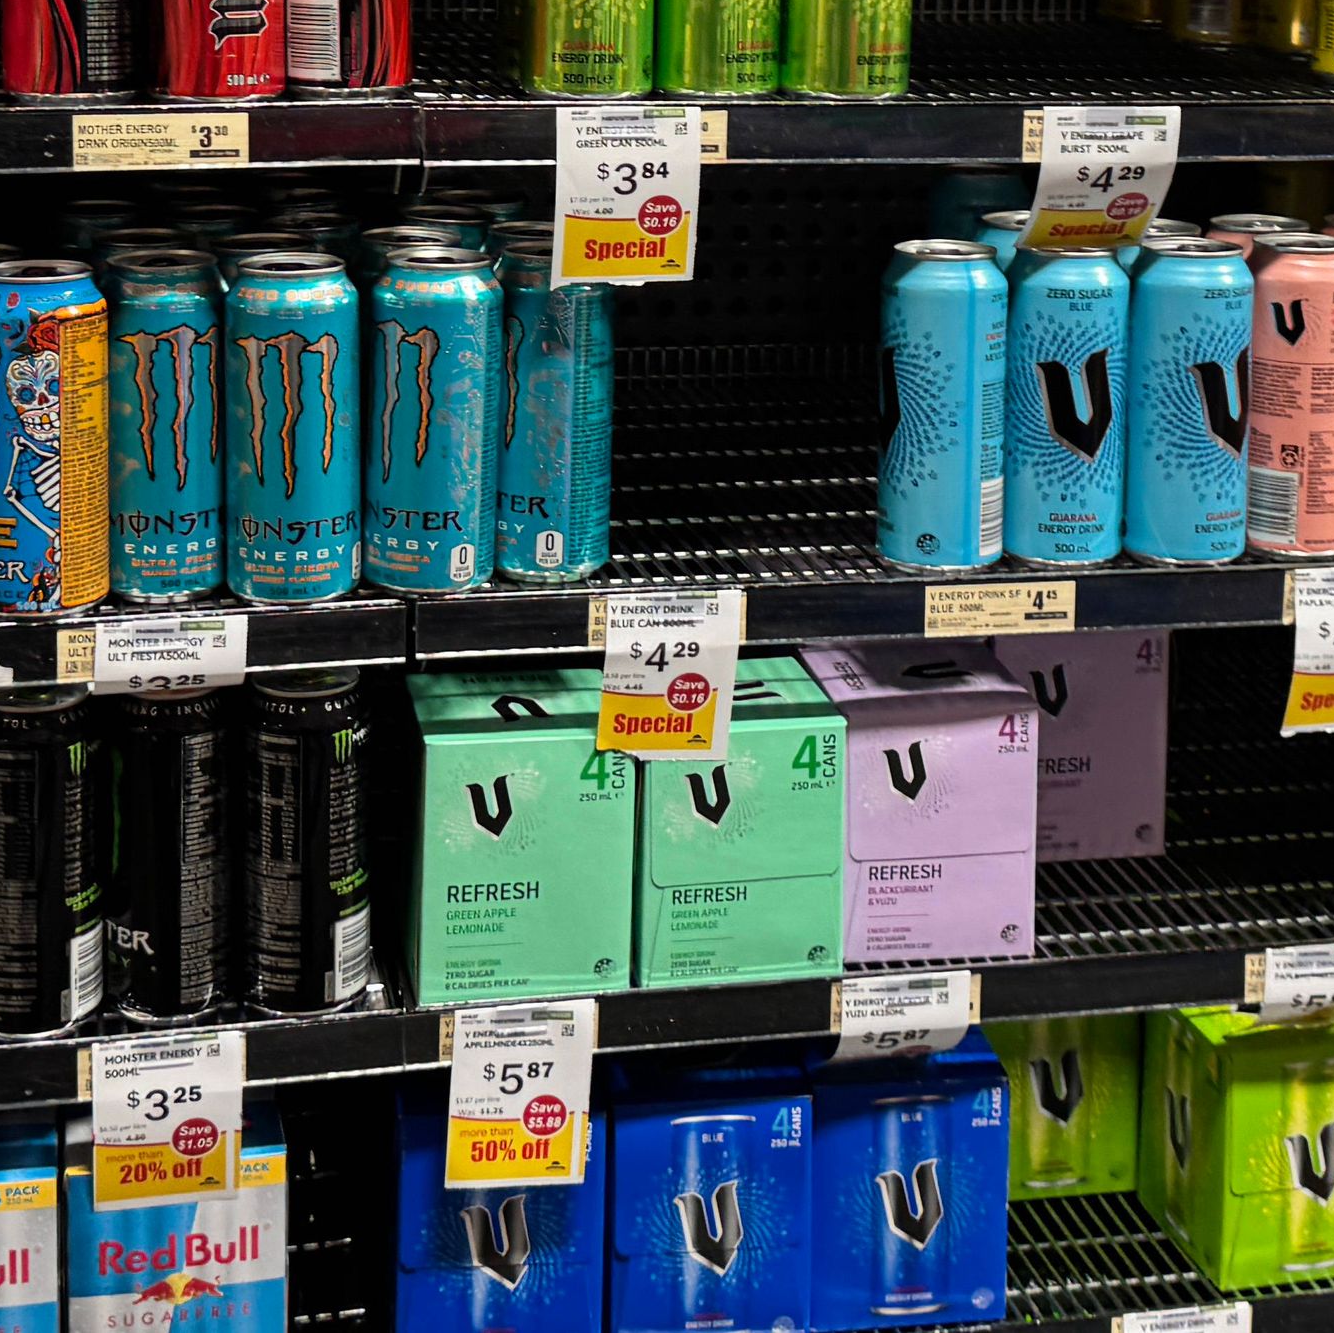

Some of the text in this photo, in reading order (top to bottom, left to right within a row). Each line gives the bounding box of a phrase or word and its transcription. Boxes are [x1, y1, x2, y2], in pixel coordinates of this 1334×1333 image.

[551, 51, 624, 65] ENERGY DRINK
[78, 124, 169, 135] MOTHER ENERGY
[645, 203, 677, 214] Save
[643, 217, 678, 229] $0.16
[1049, 220, 1127, 239] Special
[584, 237, 667, 262] Special
[1046, 287, 1113, 301] ZERO SUGAR
[1068, 301, 1093, 312] BLUE
[1037, 523, 1073, 535] ENERGY
[238, 544, 346, 562] ENERGY
[620, 605, 661, 615] ENERGY
[663, 604, 694, 614] DRINK
[613, 713, 693, 735] Special
[868, 862, 943, 881] REFRESH
[447, 881, 540, 904] REFRESH
[672, 885, 748, 906] REFRESH
[446, 907, 517, 920] GREEN APPLE
[446, 922, 505, 935] LEMONADE
[530, 1101, 562, 1114] Save
[527, 1116, 562, 1129] $5.88
[470, 1138, 551, 1163] 50% off
[119, 1158, 204, 1185] 20% off
[97, 1224, 260, 1276] Red Bull
